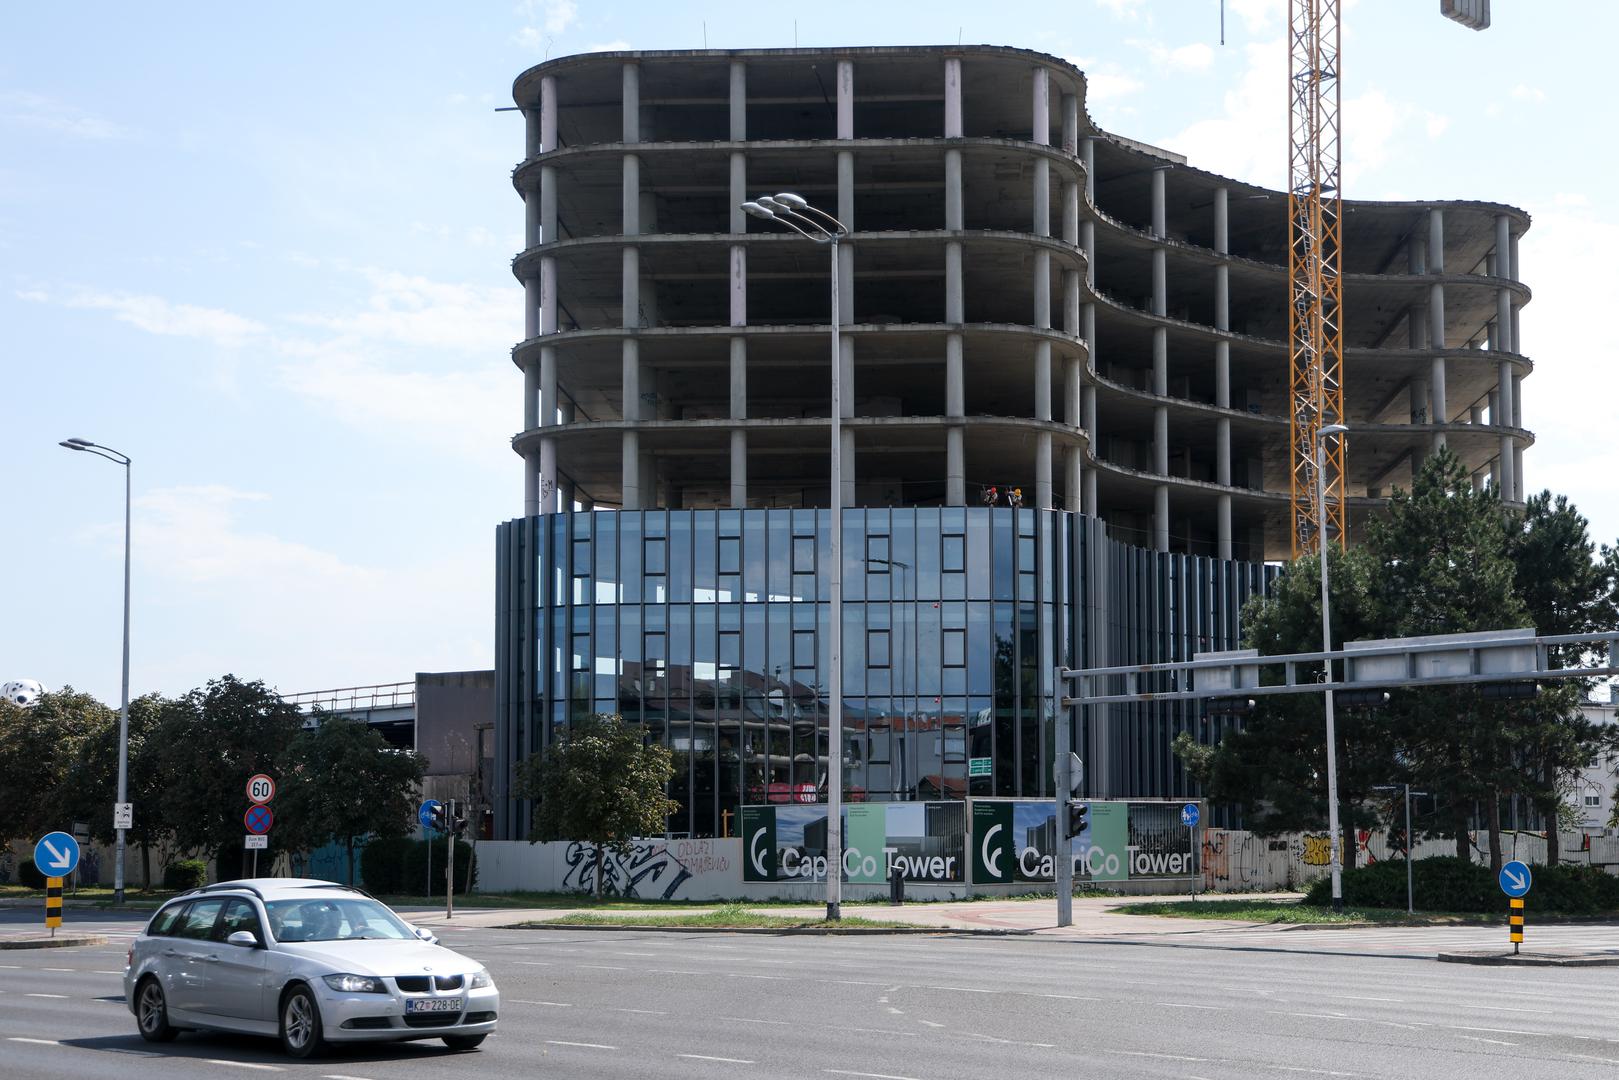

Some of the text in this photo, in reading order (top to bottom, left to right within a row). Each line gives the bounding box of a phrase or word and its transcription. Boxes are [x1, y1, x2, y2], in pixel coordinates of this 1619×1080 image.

[253, 782, 269, 797] 60
[782, 847, 955, 882] CapCo Tower
[1124, 845, 1192, 875] Tower
[414, 1000, 425, 1011] KZ
